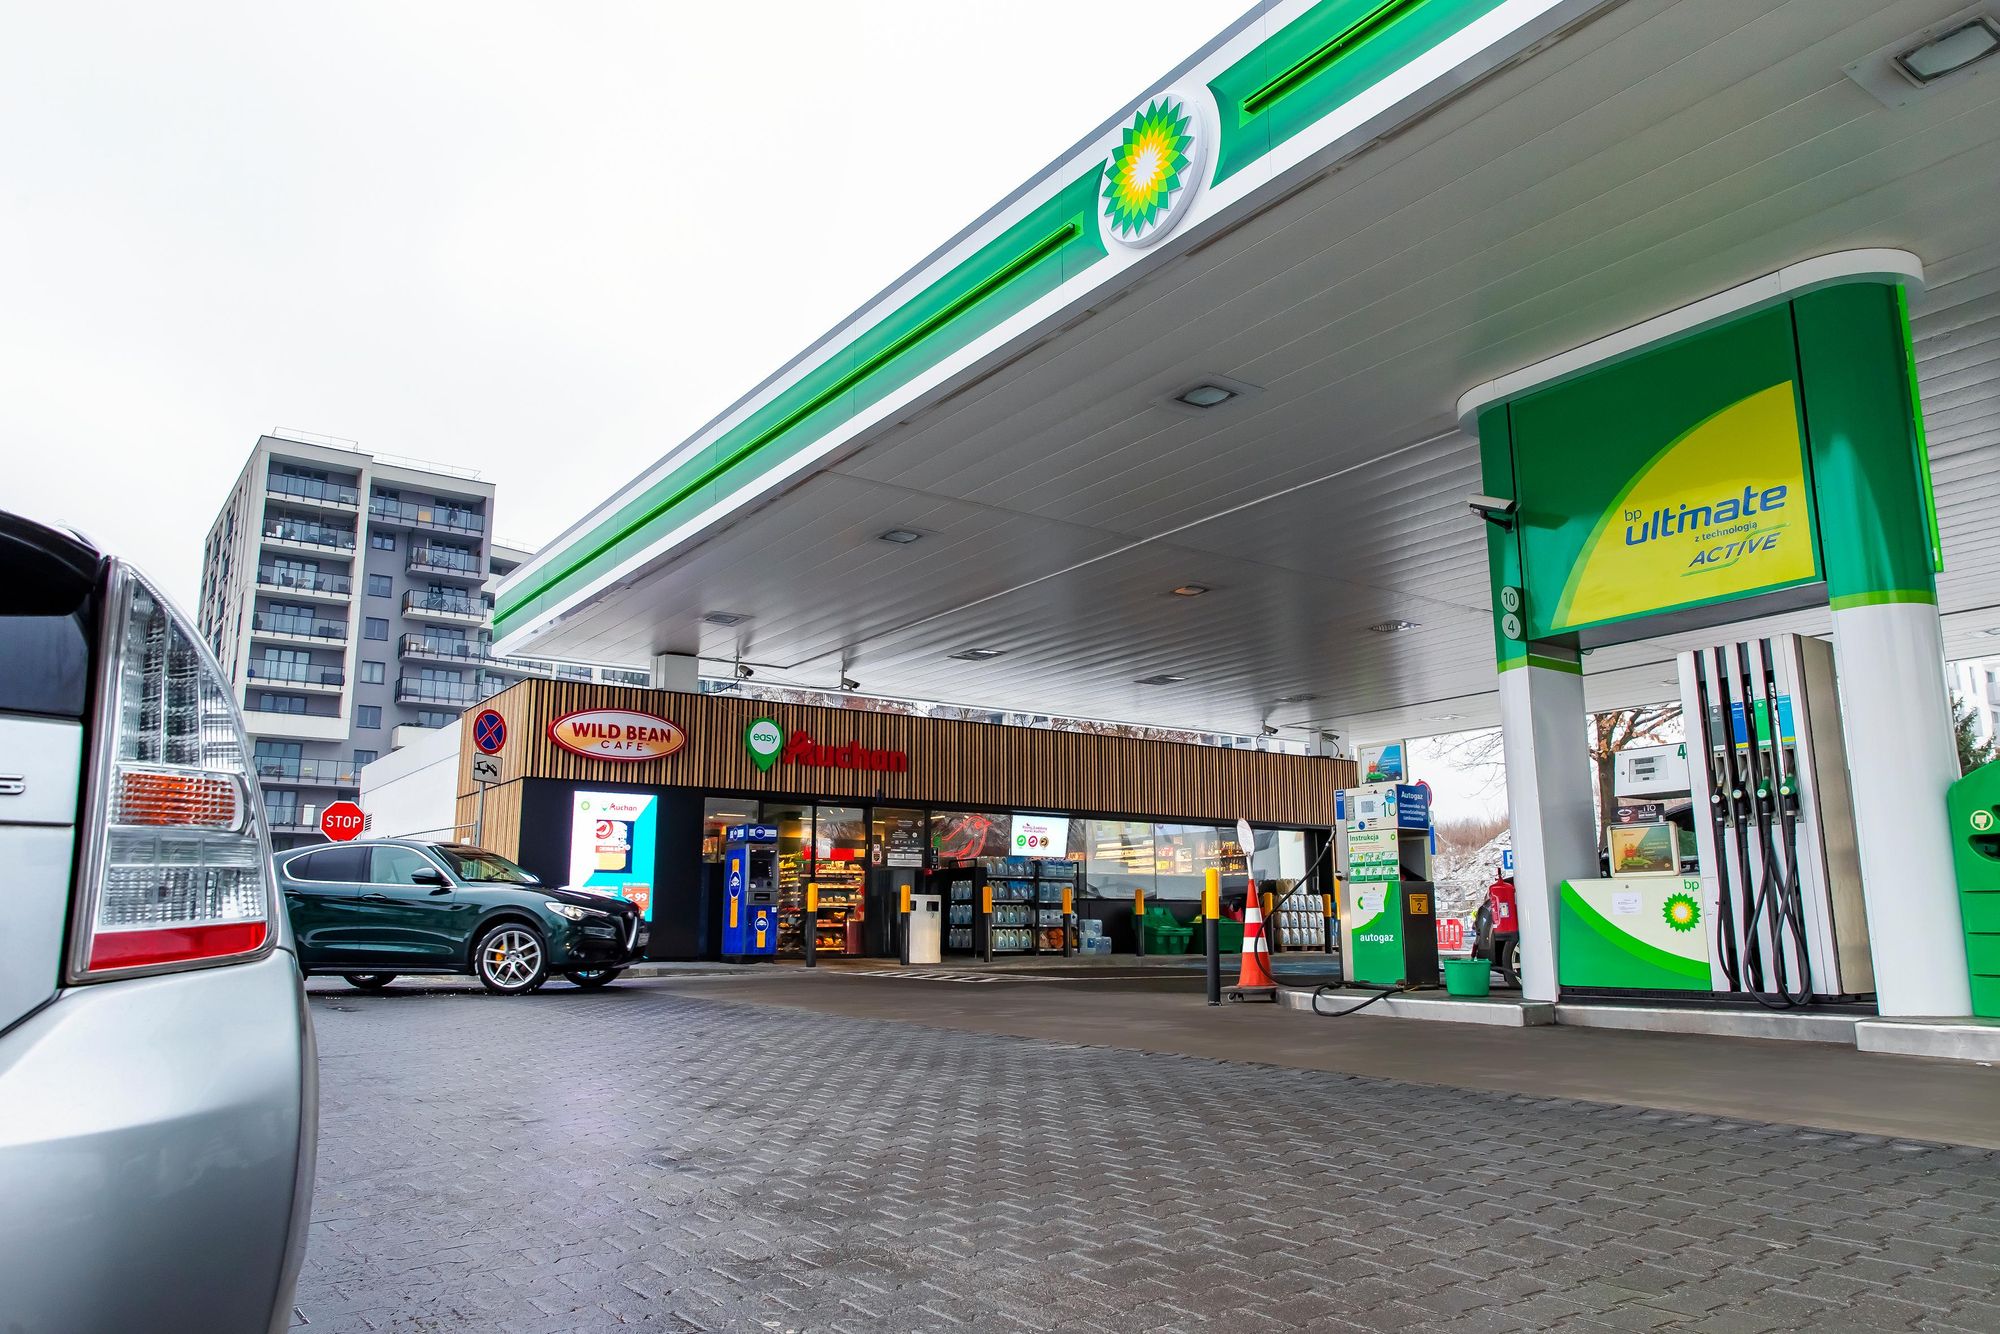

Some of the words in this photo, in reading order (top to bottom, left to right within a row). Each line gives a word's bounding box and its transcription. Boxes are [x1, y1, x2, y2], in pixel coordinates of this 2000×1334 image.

[1624, 508, 1642, 523] bp
[1625, 485, 1788, 546] ultimate
[1694, 535, 1700, 543] z
[1702, 521, 1758, 541] technologią
[1688, 531, 1782, 568] ACTIVE
[1503, 592, 1516, 607] 10
[1507, 619, 1515, 633] 4
[571, 722, 621, 739] WILD
[626, 725, 671, 743] BEAN
[600, 740, 644, 751] CAFE
[753, 733, 778, 744] easy
[783, 730, 908, 773] Auchan
[1677, 744, 1687, 760] 4
[1401, 791, 1424, 800] Autogaz
[609, 803, 637, 811] Auchan
[326, 815, 361, 828] STOP
[1683, 879, 1700, 892] bp
[1416, 903, 1422, 912] 2
[1360, 934, 1394, 943] autogaz
